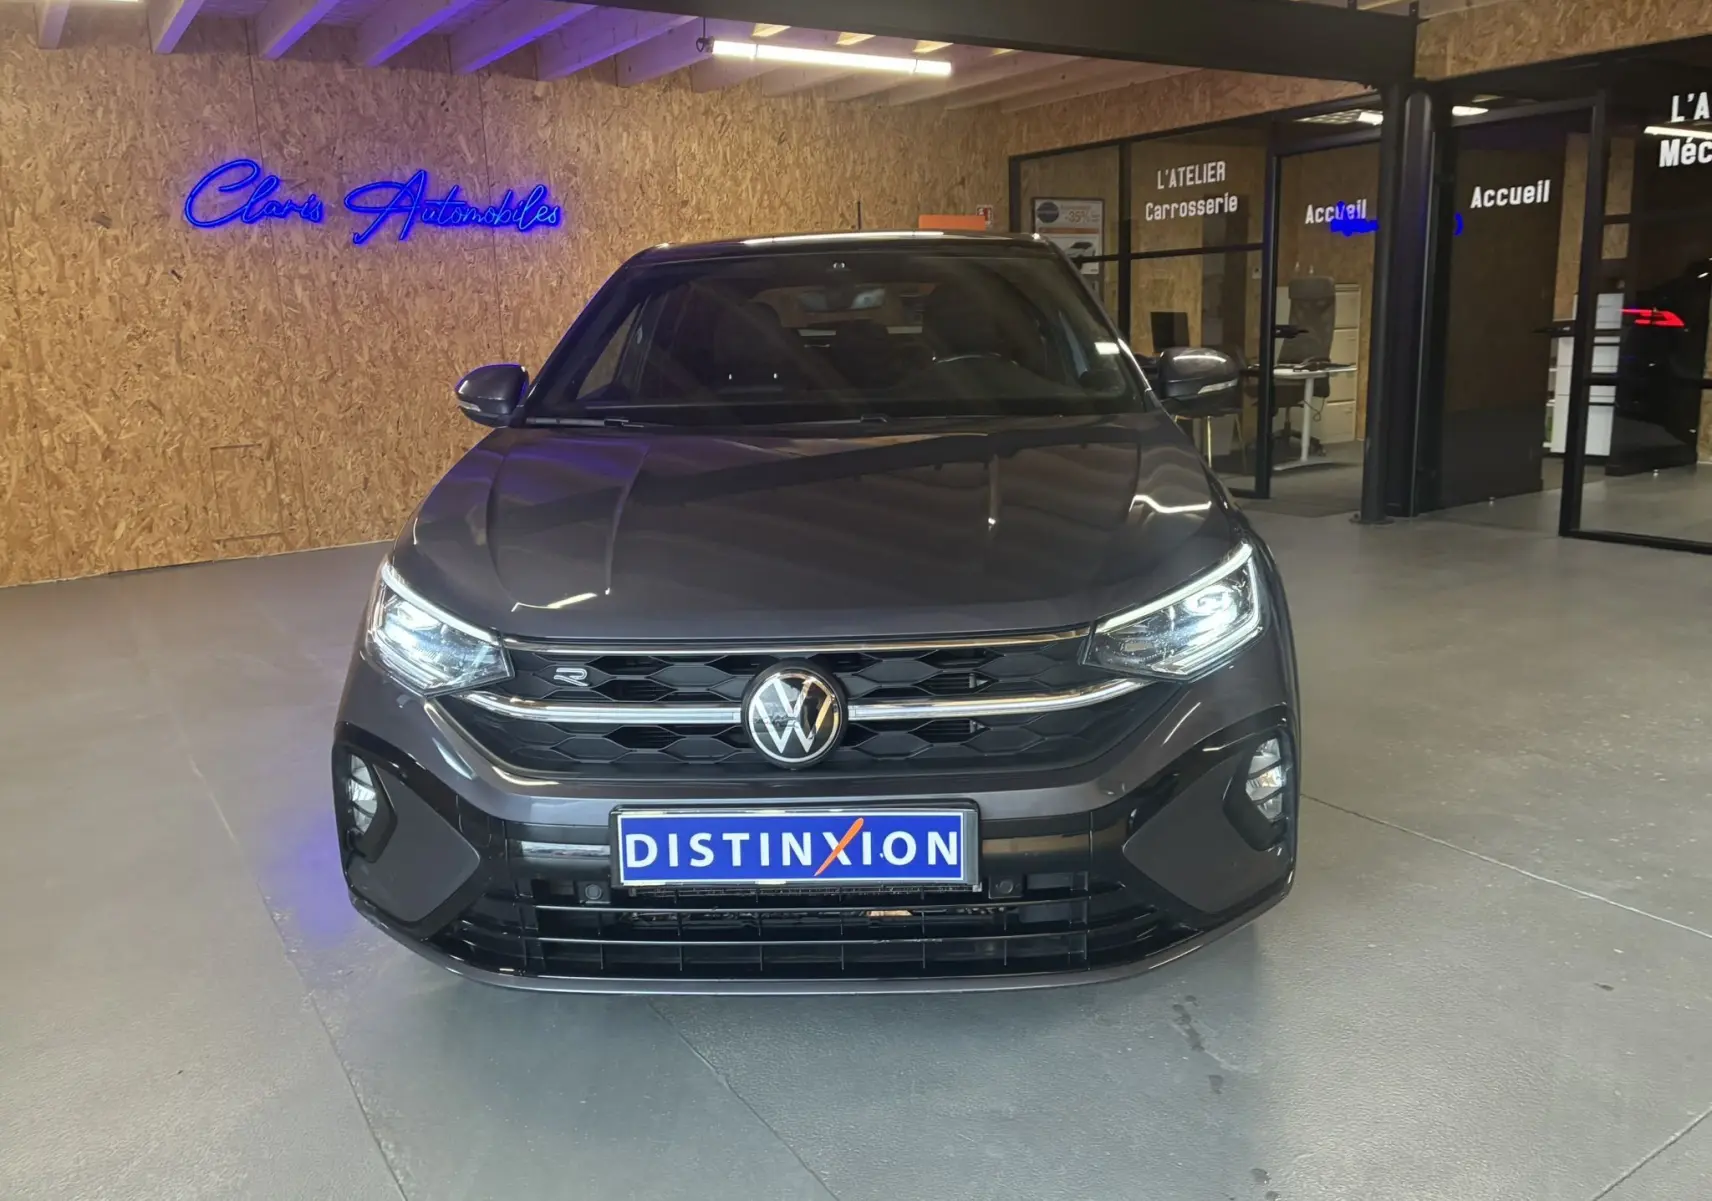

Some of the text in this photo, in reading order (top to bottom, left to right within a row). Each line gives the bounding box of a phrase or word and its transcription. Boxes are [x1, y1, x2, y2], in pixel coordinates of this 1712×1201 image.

[1157, 161, 1226, 190] L'ATELIER
[185, 159, 561, 244] Claris Automobiles
[1145, 192, 1238, 221] Carrosserie
[1470, 179, 1550, 209] Accueil
[1305, 199, 1367, 225] Accueil
[625, 817, 957, 876] DISTINXION
